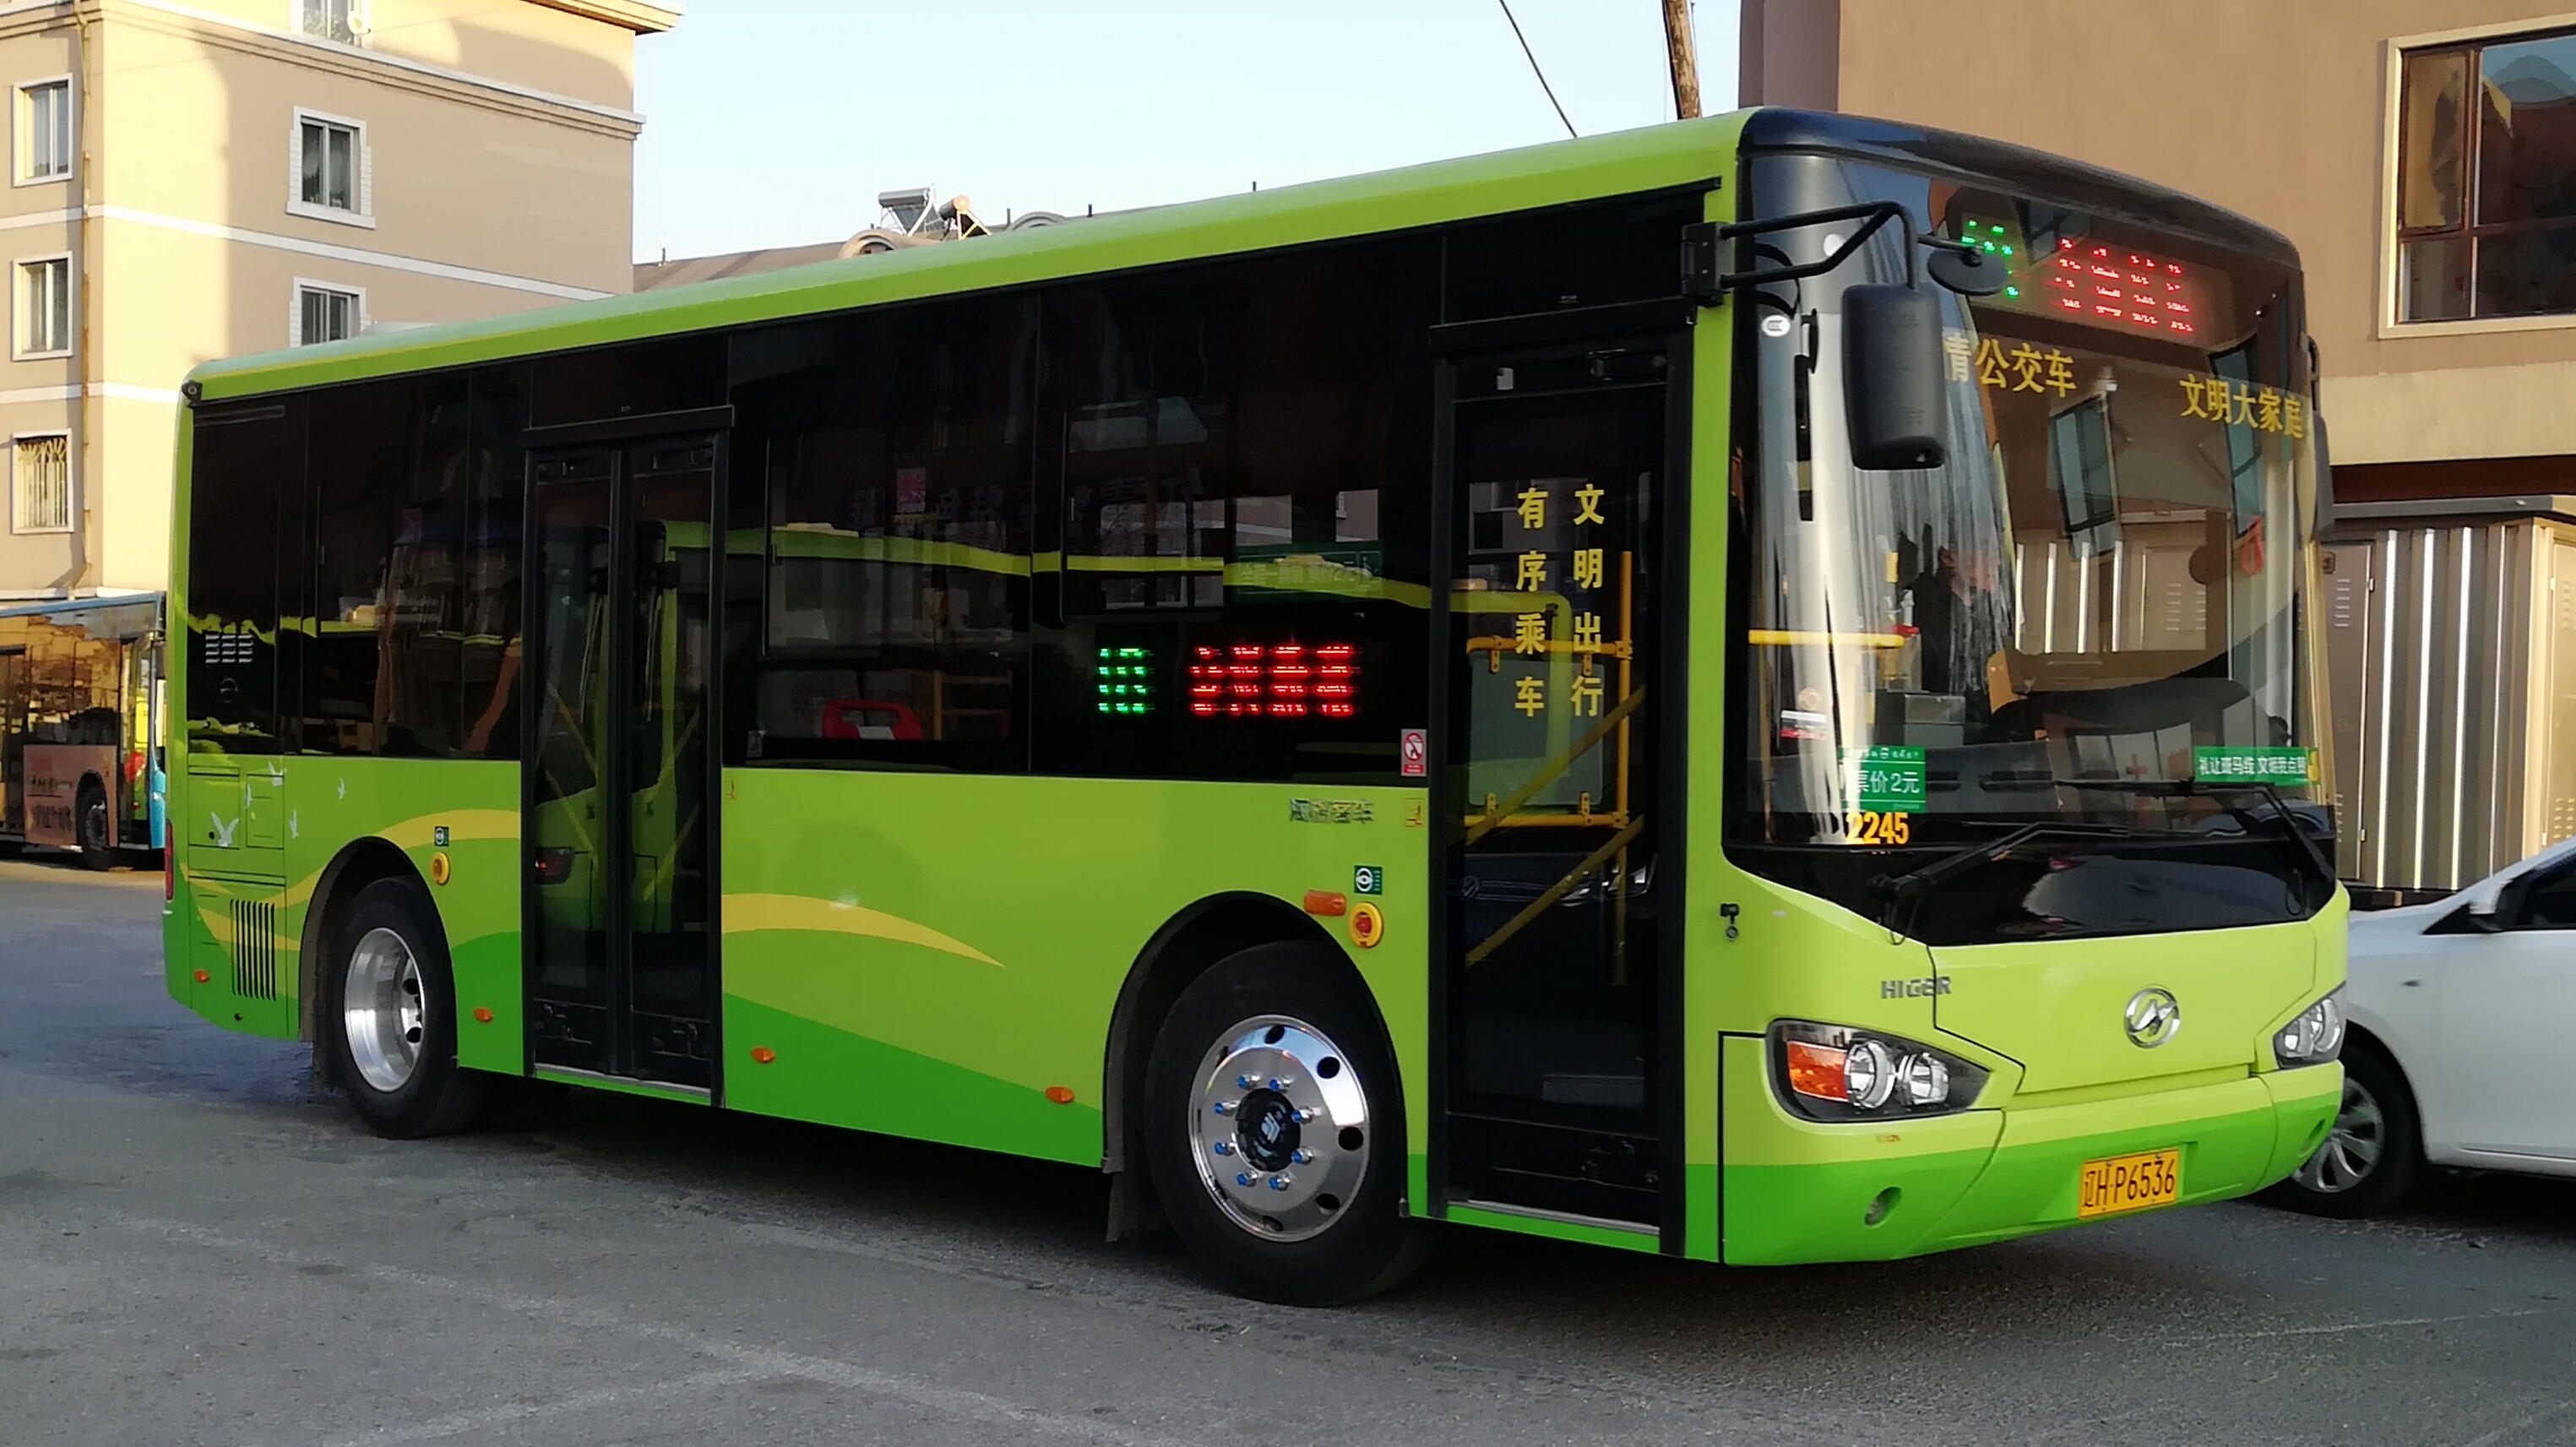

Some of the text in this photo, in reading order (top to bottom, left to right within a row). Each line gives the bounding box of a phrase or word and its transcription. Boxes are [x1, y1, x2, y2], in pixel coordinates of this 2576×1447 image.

[2179, 373, 2303, 438] 文明大家庭
[1514, 487, 1548, 717] 有序乘车
[1571, 483, 1605, 717] 文明出行
[1845, 811, 1910, 845] 2245
[1881, 976, 1952, 999] HIGER
